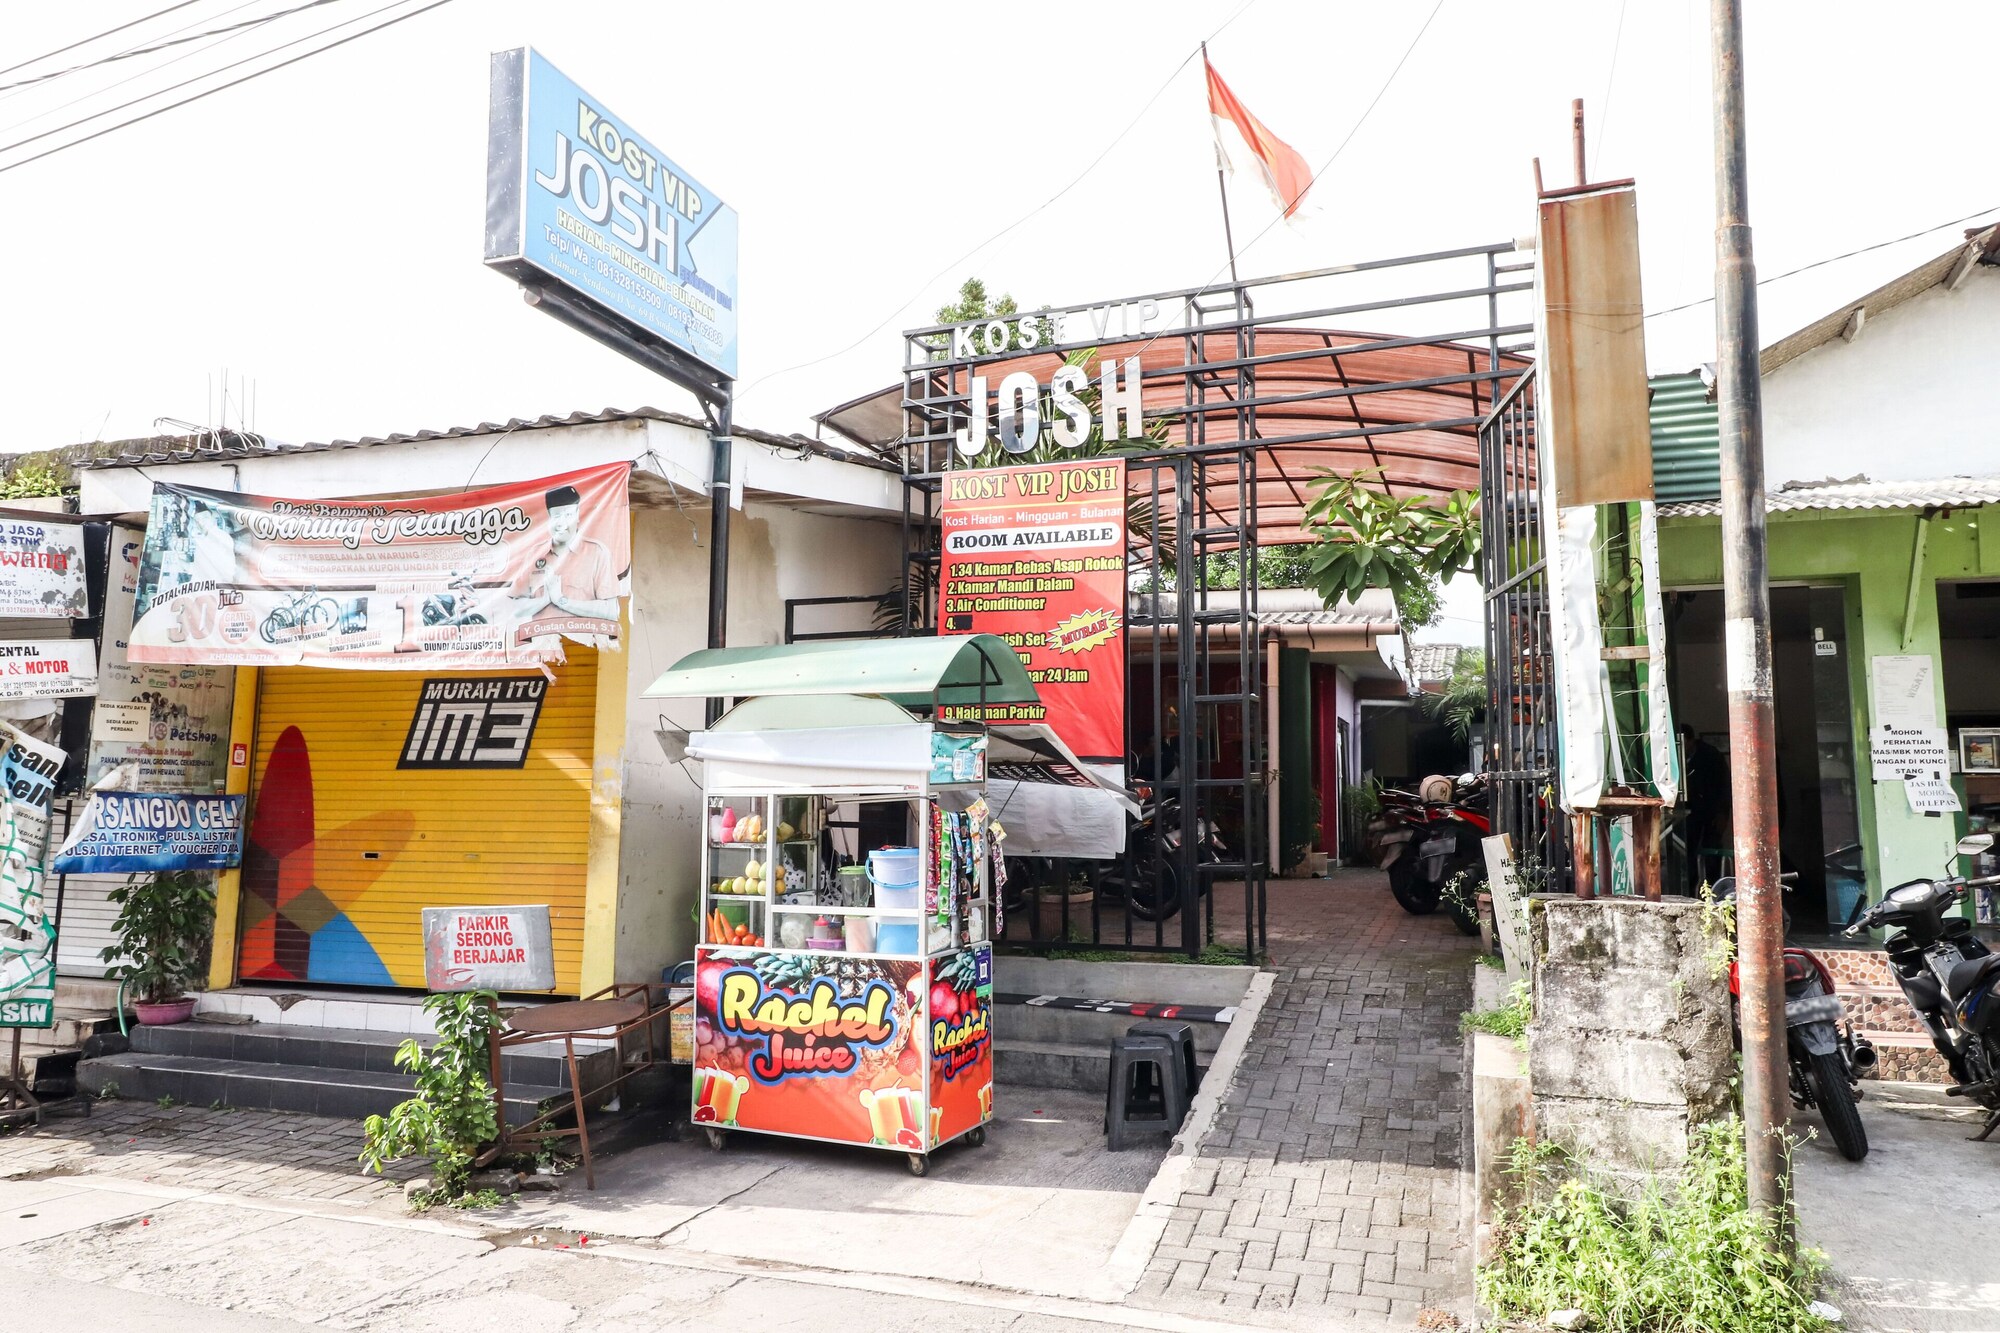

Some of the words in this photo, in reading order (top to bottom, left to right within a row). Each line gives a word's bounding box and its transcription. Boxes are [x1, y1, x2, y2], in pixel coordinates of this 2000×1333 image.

[578, 98, 657, 193] KOST
[661, 164, 702, 224] VIP
[535, 130, 679, 276] JOSH
[572, 241, 588, 265] Wa
[558, 208, 604, 253] HARIAN
[610, 243, 666, 292] MINGGUAN
[672, 283, 716, 322] BULANAN
[954, 311, 1066, 359] KOST
[1087, 299, 1159, 340] VIP
[956, 356, 1143, 456] JOSH
[949, 473, 1009, 501] KOST
[1014, 471, 1054, 496] VIP
[1056, 466, 1118, 502] JOSH
[945, 516, 968, 527] Kost
[971, 514, 1004, 525] Harian
[1016, 511, 1069, 524] Mingguan
[1080, 507, 1123, 518] Bulanan
[9, 525, 44, 537] JASA
[236, 510, 366, 549] Warung
[372, 506, 531, 546] Tetangga
[11, 536, 41, 546] STNK
[952, 534, 1008, 549] ROOM
[1013, 528, 1113, 546] AVAILABLE
[309, 552, 364, 561] BERBELANJA
[366, 552, 376, 560] DI
[377, 551, 419, 560] WARUNG
[974, 562, 1014, 576] Kamar
[1014, 560, 1052, 575] Bebas
[1053, 558, 1083, 574] Asap
[1084, 556, 1123, 571] Rokok
[302, 564, 366, 573] MENDAPATKAN
[368, 563, 401, 571] KUPON
[403, 562, 439, 571] UNDIAN
[152, 588, 179, 608] TOTAL
[181, 580, 215, 595] HADIAH
[947, 580, 996, 595] 2.Kamar
[997, 578, 1034, 593] Mandi
[1036, 577, 1074, 592] Dalam
[218, 589, 244, 609] juta
[974, 597, 1046, 612] Conditioner
[168, 594, 217, 643] 30
[225, 611, 250, 623] GRATIS
[394, 595, 422, 653] 1
[461, 626, 498, 641] MATIC
[524, 626, 532, 635] Y.
[533, 621, 564, 632] Gustan
[567, 621, 598, 632] Ganda,
[1060, 619, 1109, 646] MURAH
[424, 642, 450, 651] DIUNDI
[451, 641, 483, 651] AGUSTUS
[1025, 632, 1046, 647] Set
[8, 661, 23, 675] &
[25, 660, 69, 674] MOTOR
[1046, 669, 1063, 683] 24
[1063, 668, 1088, 683] Jam
[35, 687, 84, 695] YOGYAKARTA
[424, 682, 501, 700] MURAH
[505, 680, 544, 698] ITU
[1906, 665, 1929, 698] WISATA
[1009, 705, 1046, 720] Parkir
[170, 727, 217, 745] Petshop
[406, 702, 538, 762] IM3
[95, 796, 192, 829] RSANGDO
[1928, 799, 1956, 807] LEPAS
[16, 811, 34, 821] SEDIA
[112, 831, 157, 843] TRONIK
[166, 831, 201, 842] PULSA
[203, 831, 237, 842] LISTRIK
[65, 844, 98, 857] ULSA
[101, 844, 161, 856] INTERNET
[170, 844, 219, 854] VOUCHER
[221, 844, 239, 854] DATA
[458, 915, 509, 931] PARKIR
[457, 931, 514, 947] SERONG
[453, 949, 525, 964] BERJAJAR
[722, 971, 893, 1044] Rachel
[933, 1009, 988, 1057] Rachel
[753, 1032, 856, 1081] Juice
[947, 1047, 978, 1078] Juice
